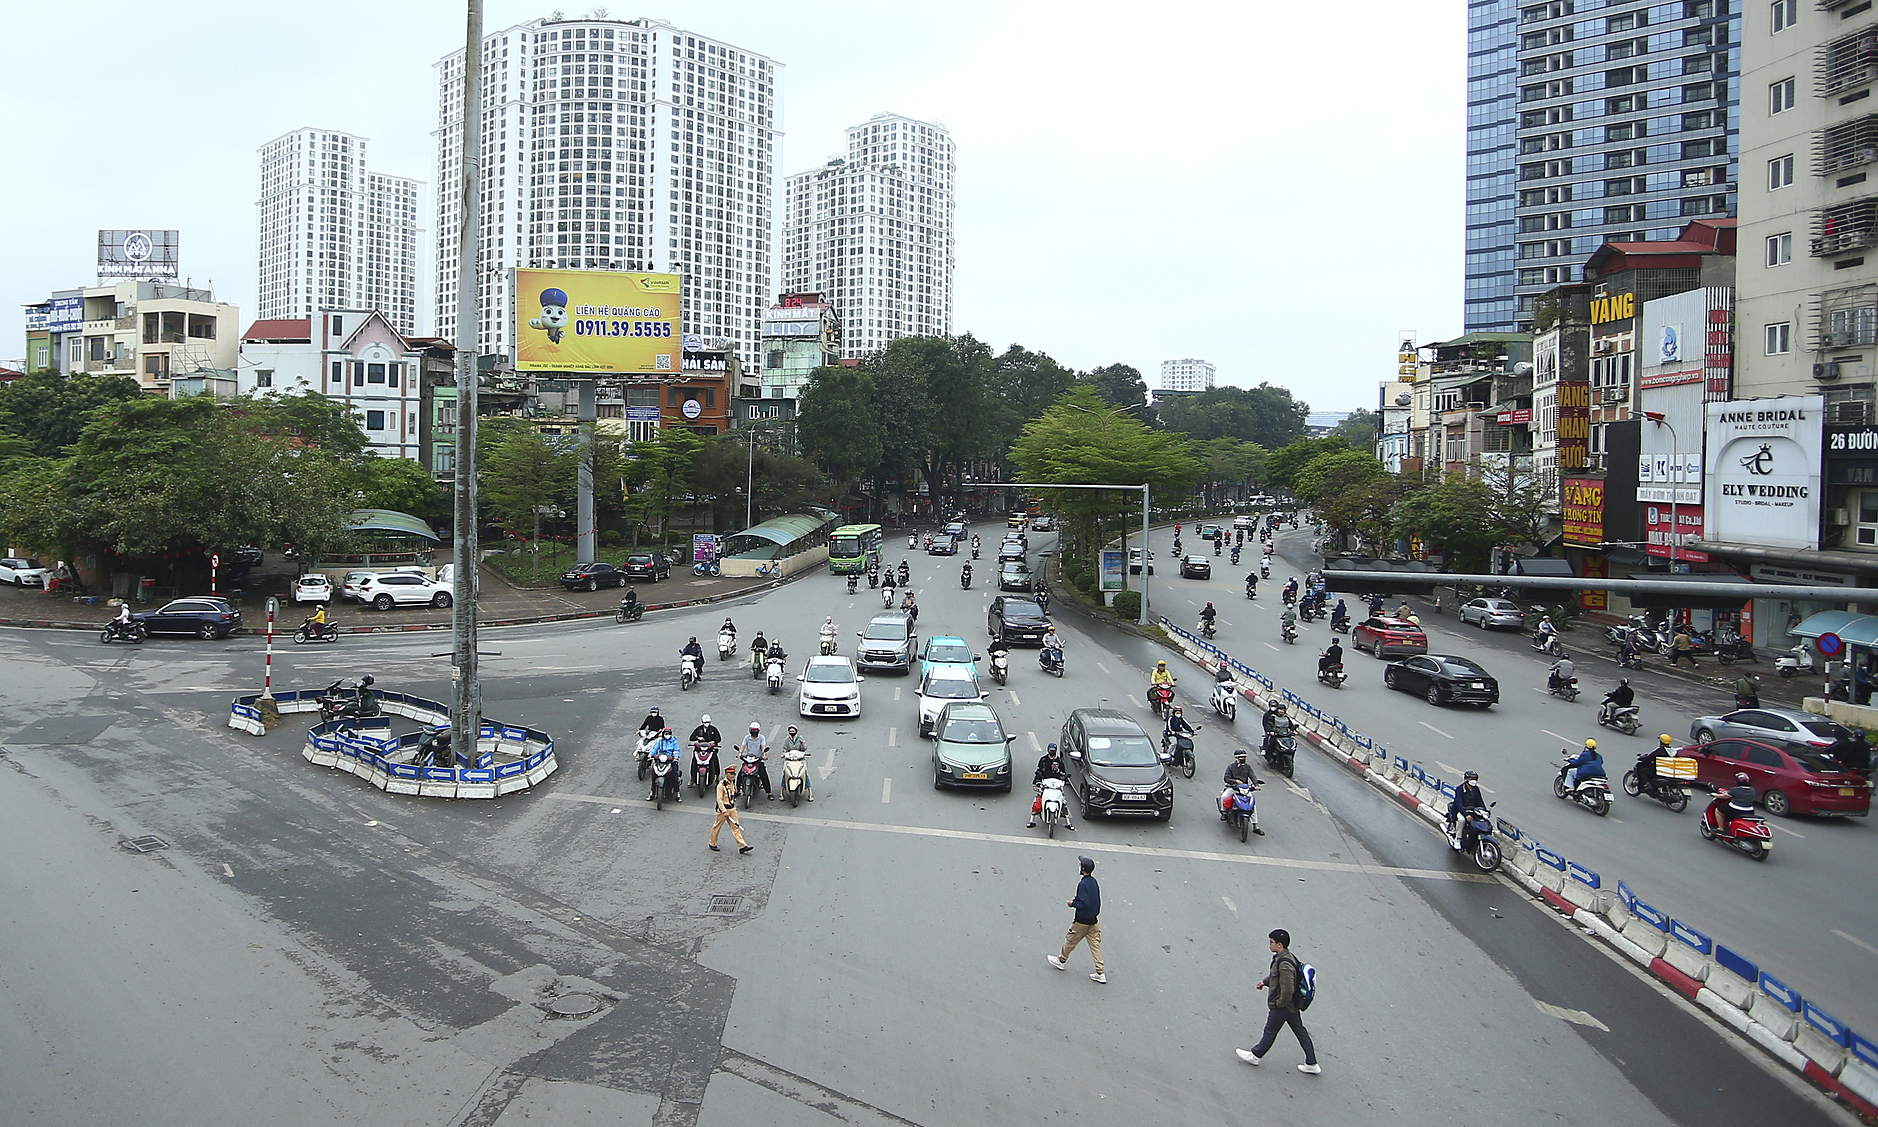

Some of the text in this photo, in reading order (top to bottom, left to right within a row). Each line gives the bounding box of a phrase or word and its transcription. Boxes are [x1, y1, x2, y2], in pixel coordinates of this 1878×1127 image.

[97, 261, 122, 274] KÍNH
[144, 264, 176, 274] ANNA
[575, 303, 661, 319] LIÊN HỆ QUẢNG CÁO
[766, 306, 815, 320] KÍNH MẮT
[1589, 291, 1635, 325] VÀNG
[575, 319, 672, 338] 0911.39.5555
[770, 322, 809, 336] LILY
[681, 354, 726, 371] HẢI SẢN
[1557, 381, 1589, 408] VÀNG
[1556, 409, 1589, 438] NHẪN
[1719, 409, 1806, 423] ANNE BRIDAL
[1830, 433, 1845, 450] 26
[1564, 481, 1603, 508] VÀNG
[1722, 484, 1809, 499] ELY WEDDING
[1588, 507, 1602, 523] TÍN
